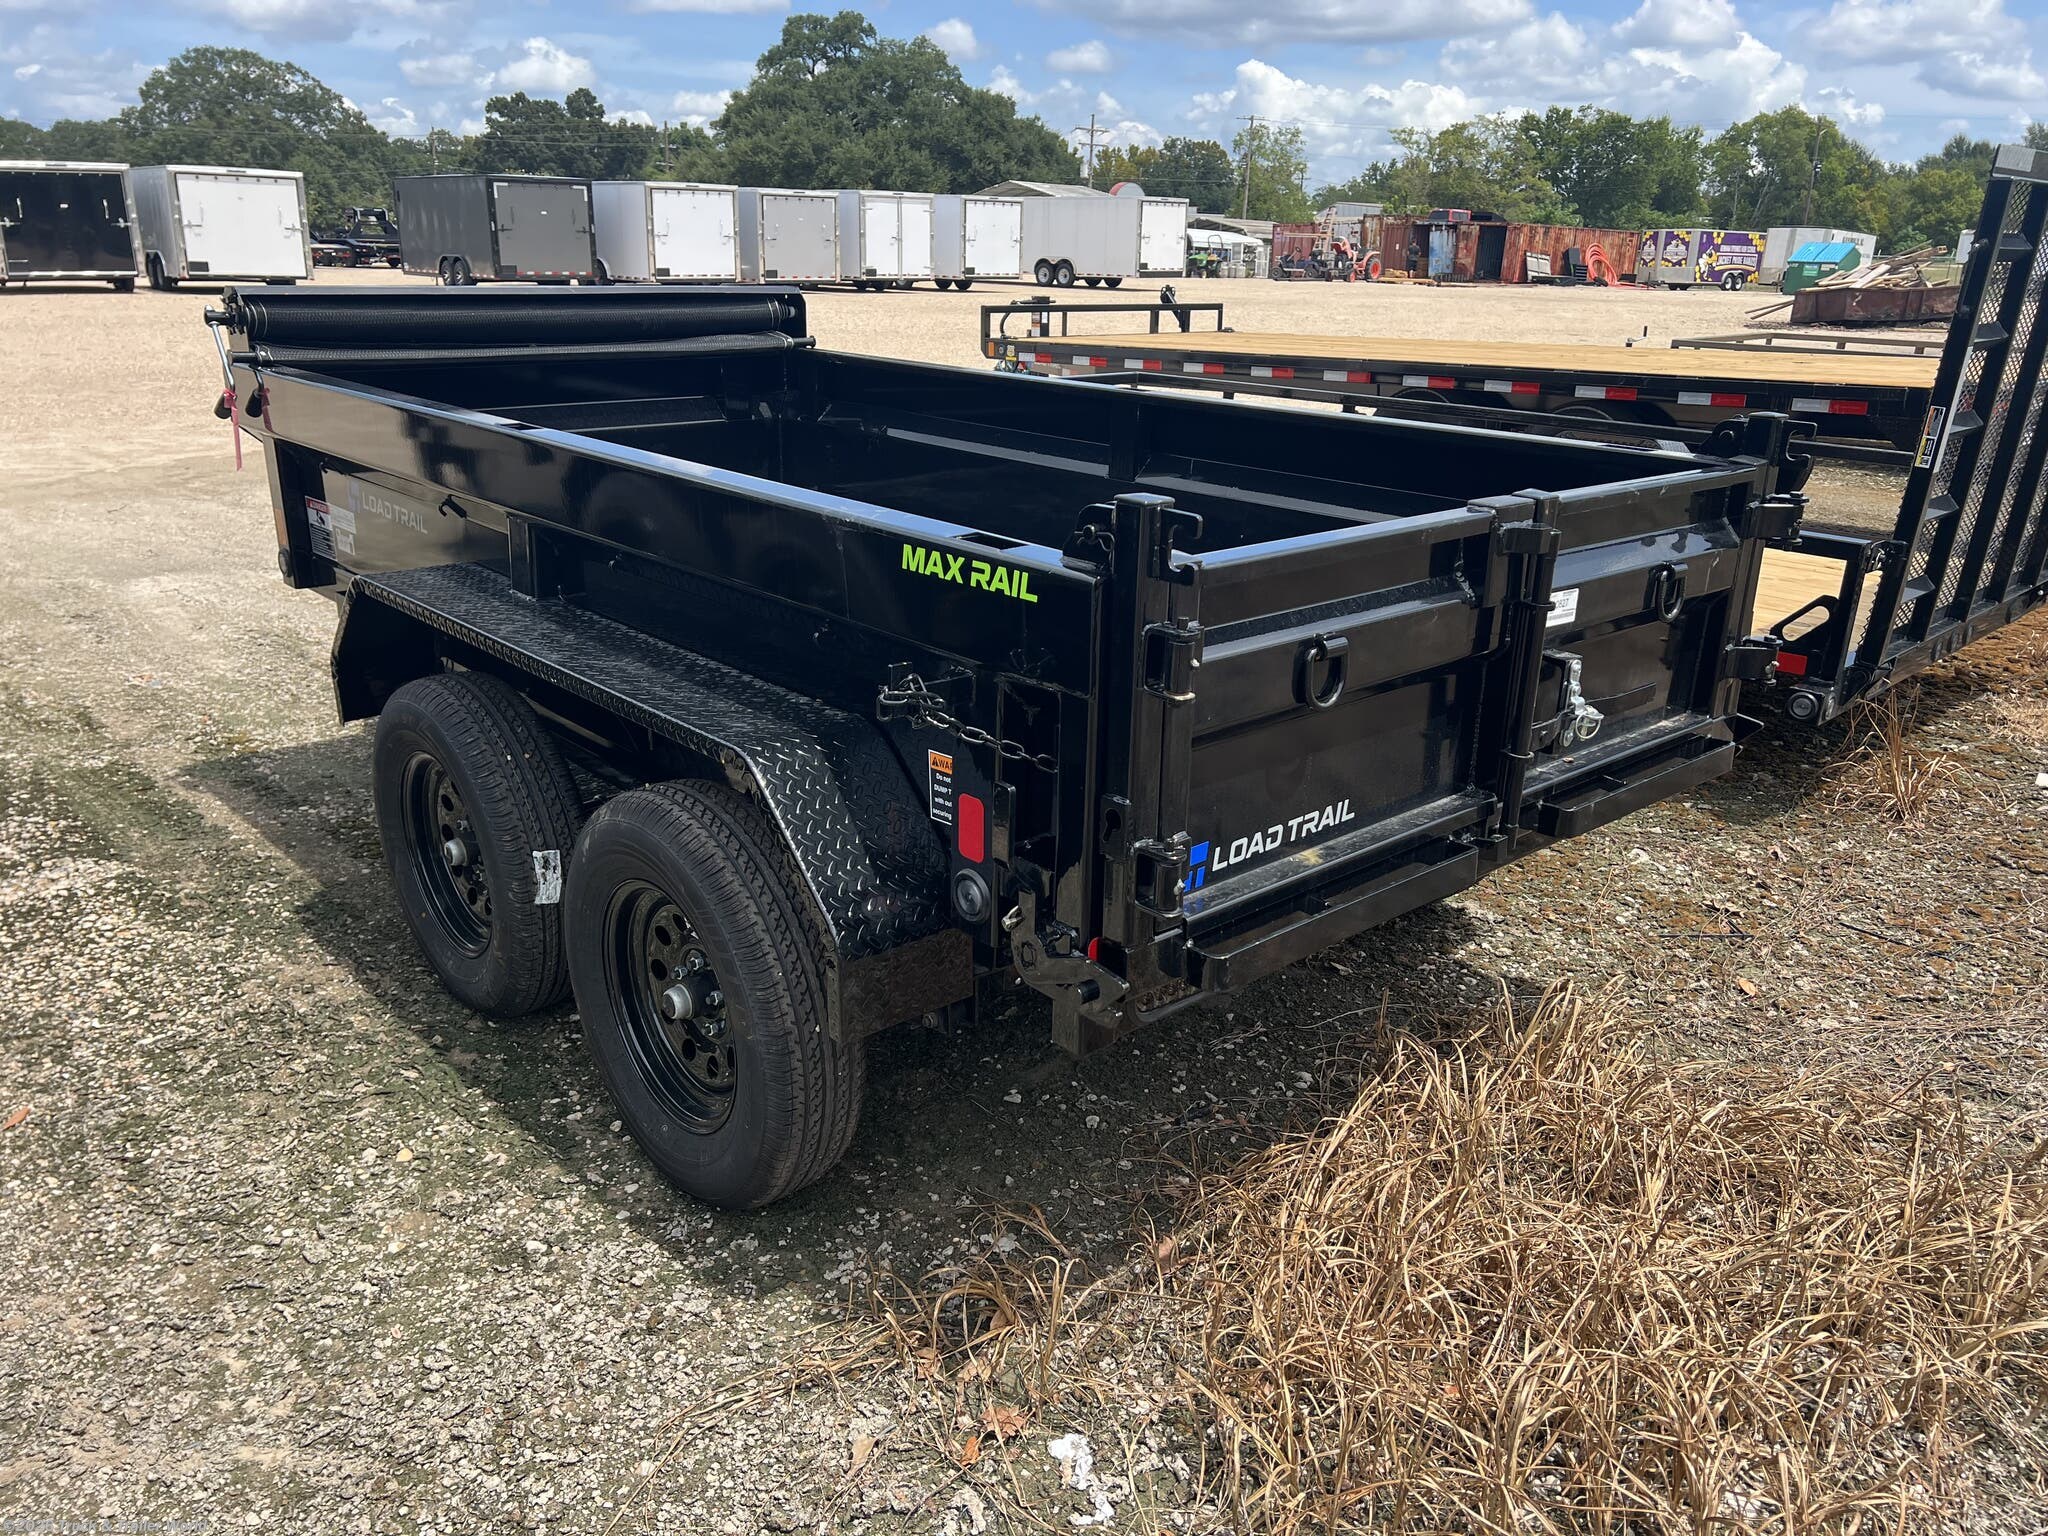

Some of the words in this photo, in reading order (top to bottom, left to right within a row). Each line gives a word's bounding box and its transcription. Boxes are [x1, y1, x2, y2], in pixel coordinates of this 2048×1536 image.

[362, 491, 392, 519] LOAD
[393, 505, 428, 534] TRAIL
[902, 544, 965, 584] MAX
[970, 560, 1038, 603] RAIL
[934, 784, 947, 794] DUMP
[943, 776, 951, 784] not
[933, 809, 951, 820] securing
[1212, 824, 1284, 872] LOAD
[1287, 799, 1356, 842] TRAIL
